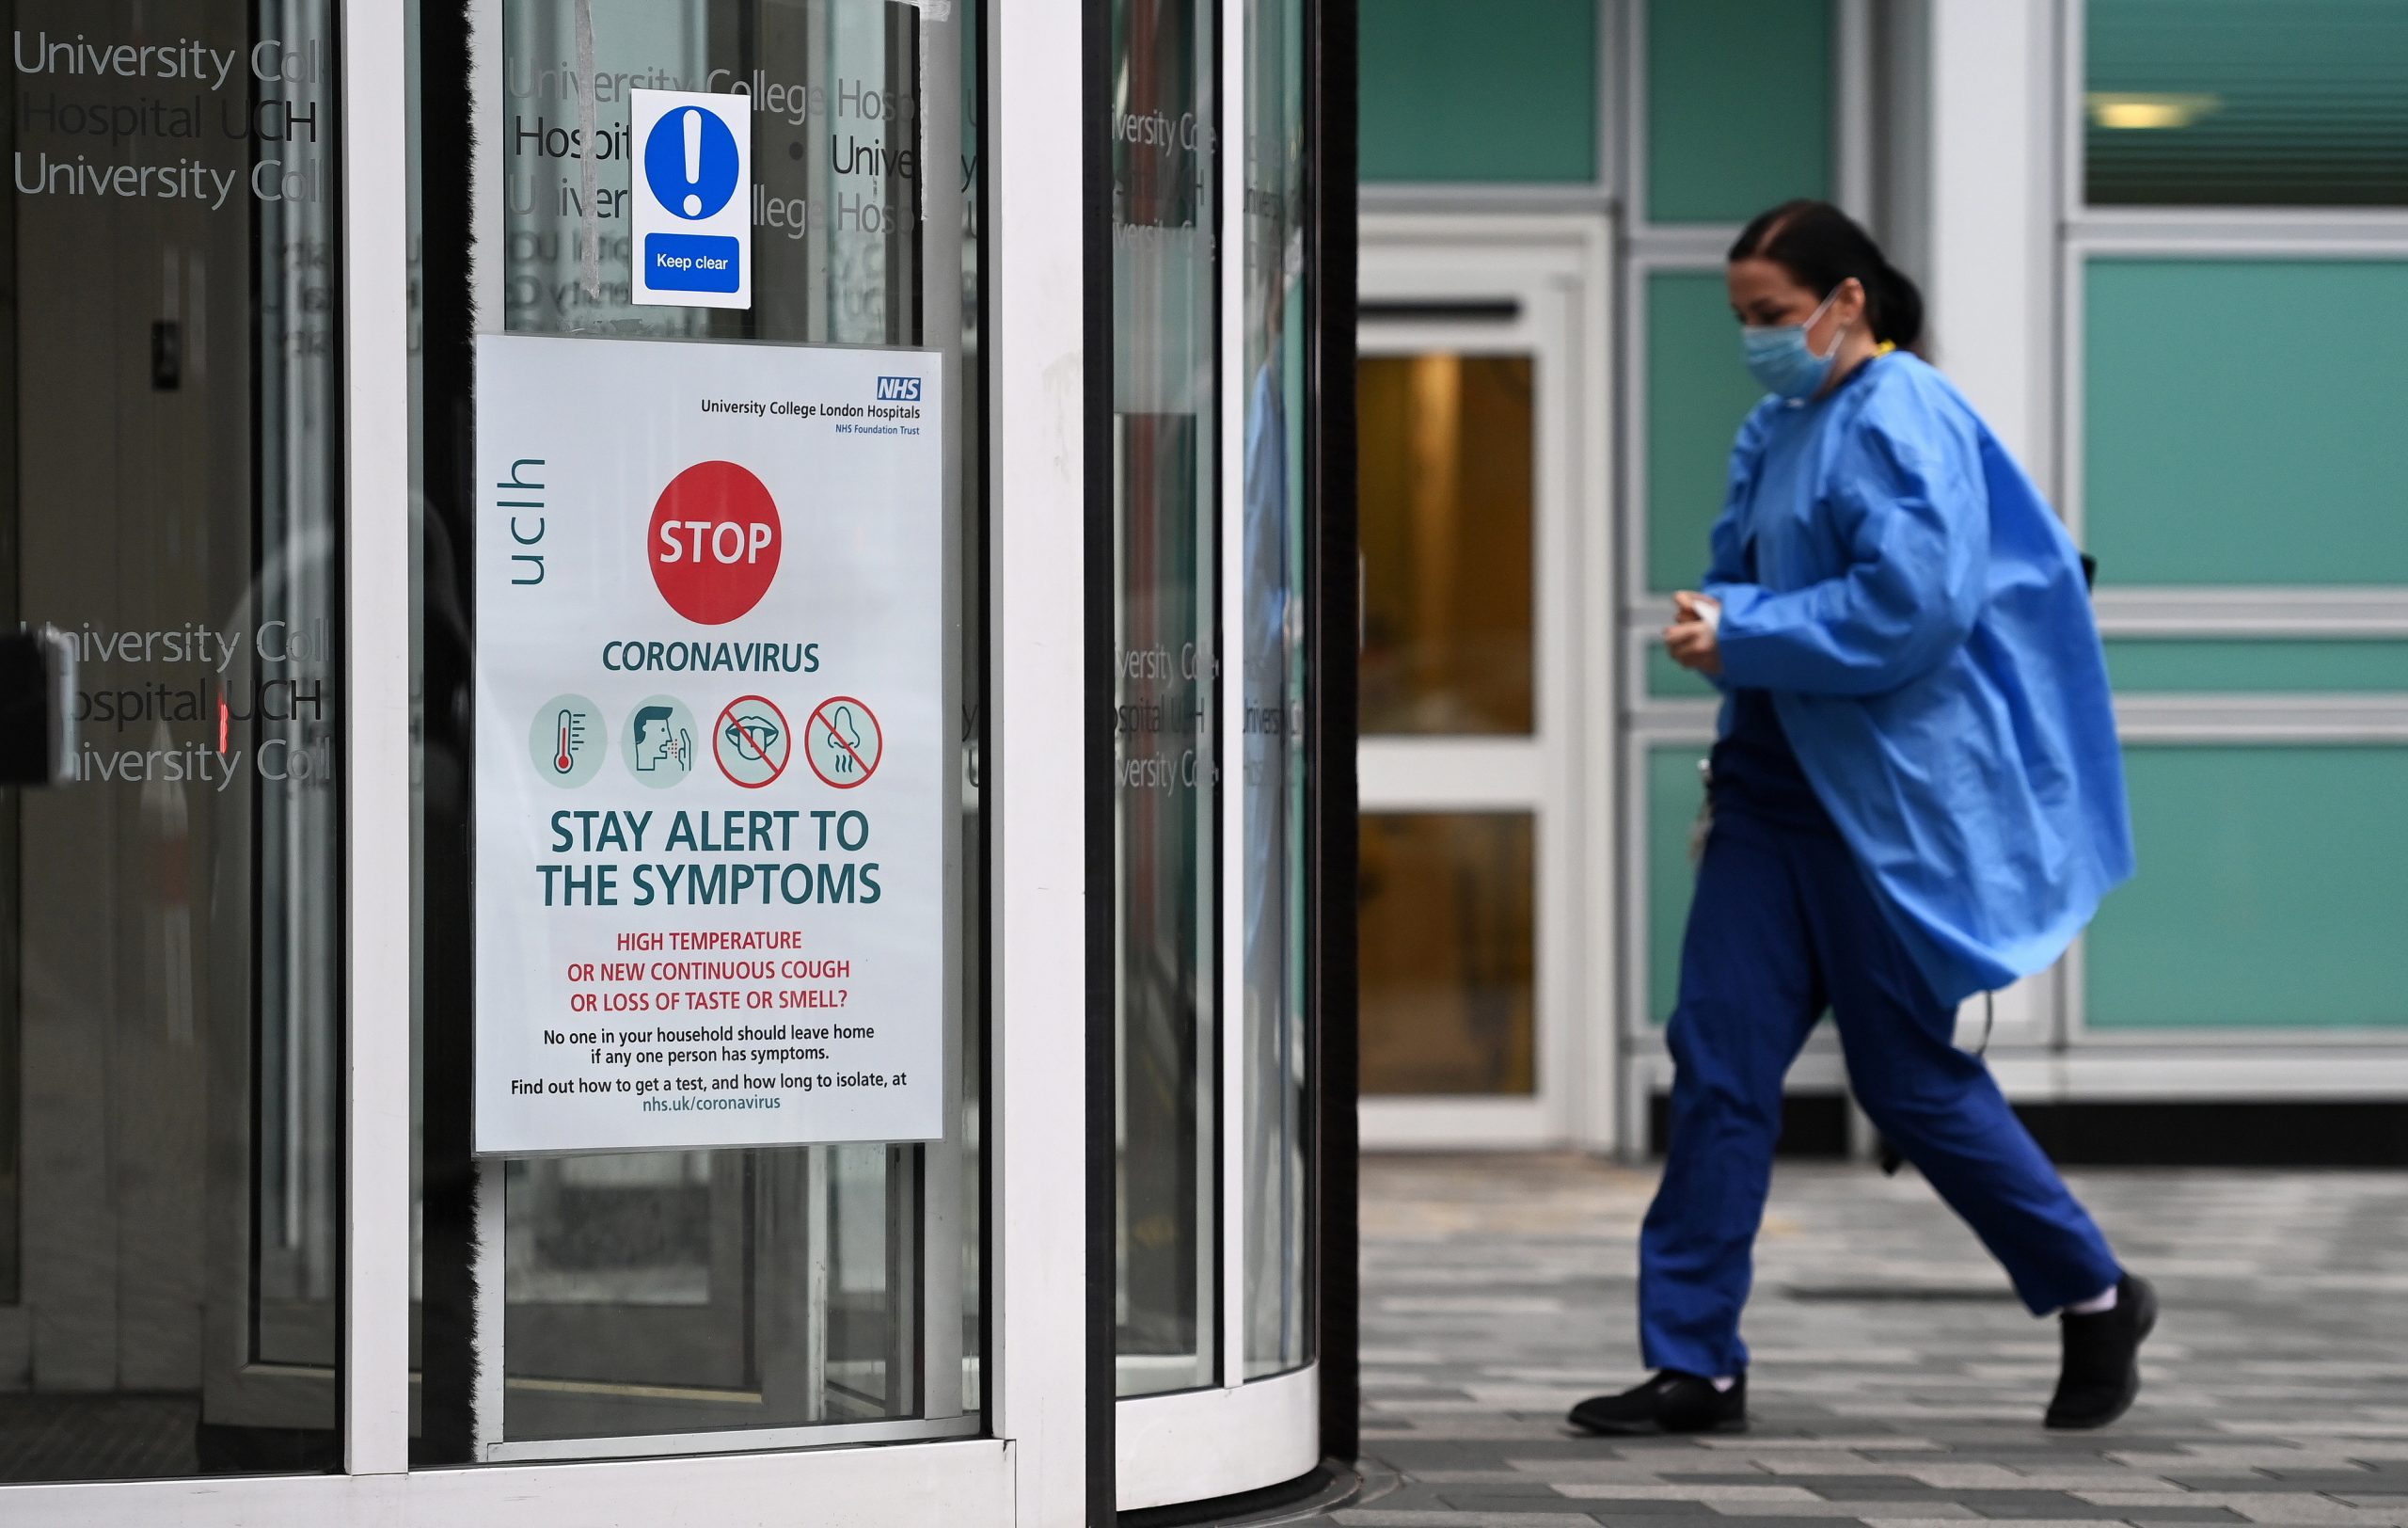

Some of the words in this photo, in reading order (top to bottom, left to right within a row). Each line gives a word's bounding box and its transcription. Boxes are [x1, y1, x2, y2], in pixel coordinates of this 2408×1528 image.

[14, 31, 235, 91] University
[23, 92, 200, 146] Hospital
[222, 98, 316, 142] UCH
[14, 151, 236, 211] University
[657, 253, 692, 272] Keep
[695, 255, 728, 270] clear
[878, 377, 920, 400] NHS
[701, 399, 766, 417] University
[769, 401, 816, 419] College
[819, 404, 863, 417] London
[867, 405, 921, 421] Hospitals
[835, 423, 852, 433] NHS
[854, 424, 898, 435] Foundation
[900, 425, 920, 436] Trust
[497, 459, 545, 584] uclh
[659, 520, 772, 565] STOP
[21, 621, 241, 673] niversity
[603, 641, 819, 673] CORONAVIRUS
[227, 679, 321, 721] UCH
[551, 810, 653, 852] STAY
[665, 810, 800, 852] ALERT
[810, 810, 868, 852] TO
[536, 865, 617, 906] THE
[633, 863, 880, 906] SYMPTOMS
[617, 932, 663, 950] HIGH
[669, 931, 801, 950] TEMPERATURE
[567, 963, 594, 981] OR
[601, 963, 645, 981] NEW
[651, 962, 775, 980] CONTINUOUS
[782, 961, 849, 979] COUGH
[571, 994, 597, 1011] OR
[604, 993, 649, 1011] LOSS
[656, 993, 679, 1011] OF
[685, 992, 740, 1010] TASTE
[747, 991, 772, 1009] OR
[779, 990, 848, 1009] SMELL?
[544, 1030, 564, 1044] No
[569, 1033, 596, 1044] one
[601, 1028, 614, 1043] in
[619, 1031, 653, 1048] your
[657, 1026, 734, 1043] household
[737, 1025, 786, 1041] should
[791, 1024, 829, 1040] leave
[833, 1024, 875, 1039] home
[591, 1048, 601, 1064] if
[606, 1052, 631, 1067] any
[636, 1051, 663, 1064] one
[668, 1050, 717, 1067] person
[721, 1046, 747, 1062] has
[751, 1046, 830, 1064] symptoms.
[511, 1078, 543, 1094] Find
[548, 1080, 575, 1093] out
[578, 1077, 611, 1092] how
[616, 1079, 631, 1092] to
[635, 1078, 659, 1096] get
[663, 1079, 672, 1091] a
[675, 1077, 707, 1092] test,
[711, 1074, 738, 1090] and
[743, 1074, 776, 1089] how
[780, 1073, 812, 1091] long
[816, 1074, 832, 1088] to
[836, 1071, 888, 1089] isolate,
[893, 1072, 907, 1086] at
[642, 1094, 781, 1111] nhs.uk/coronavirus
